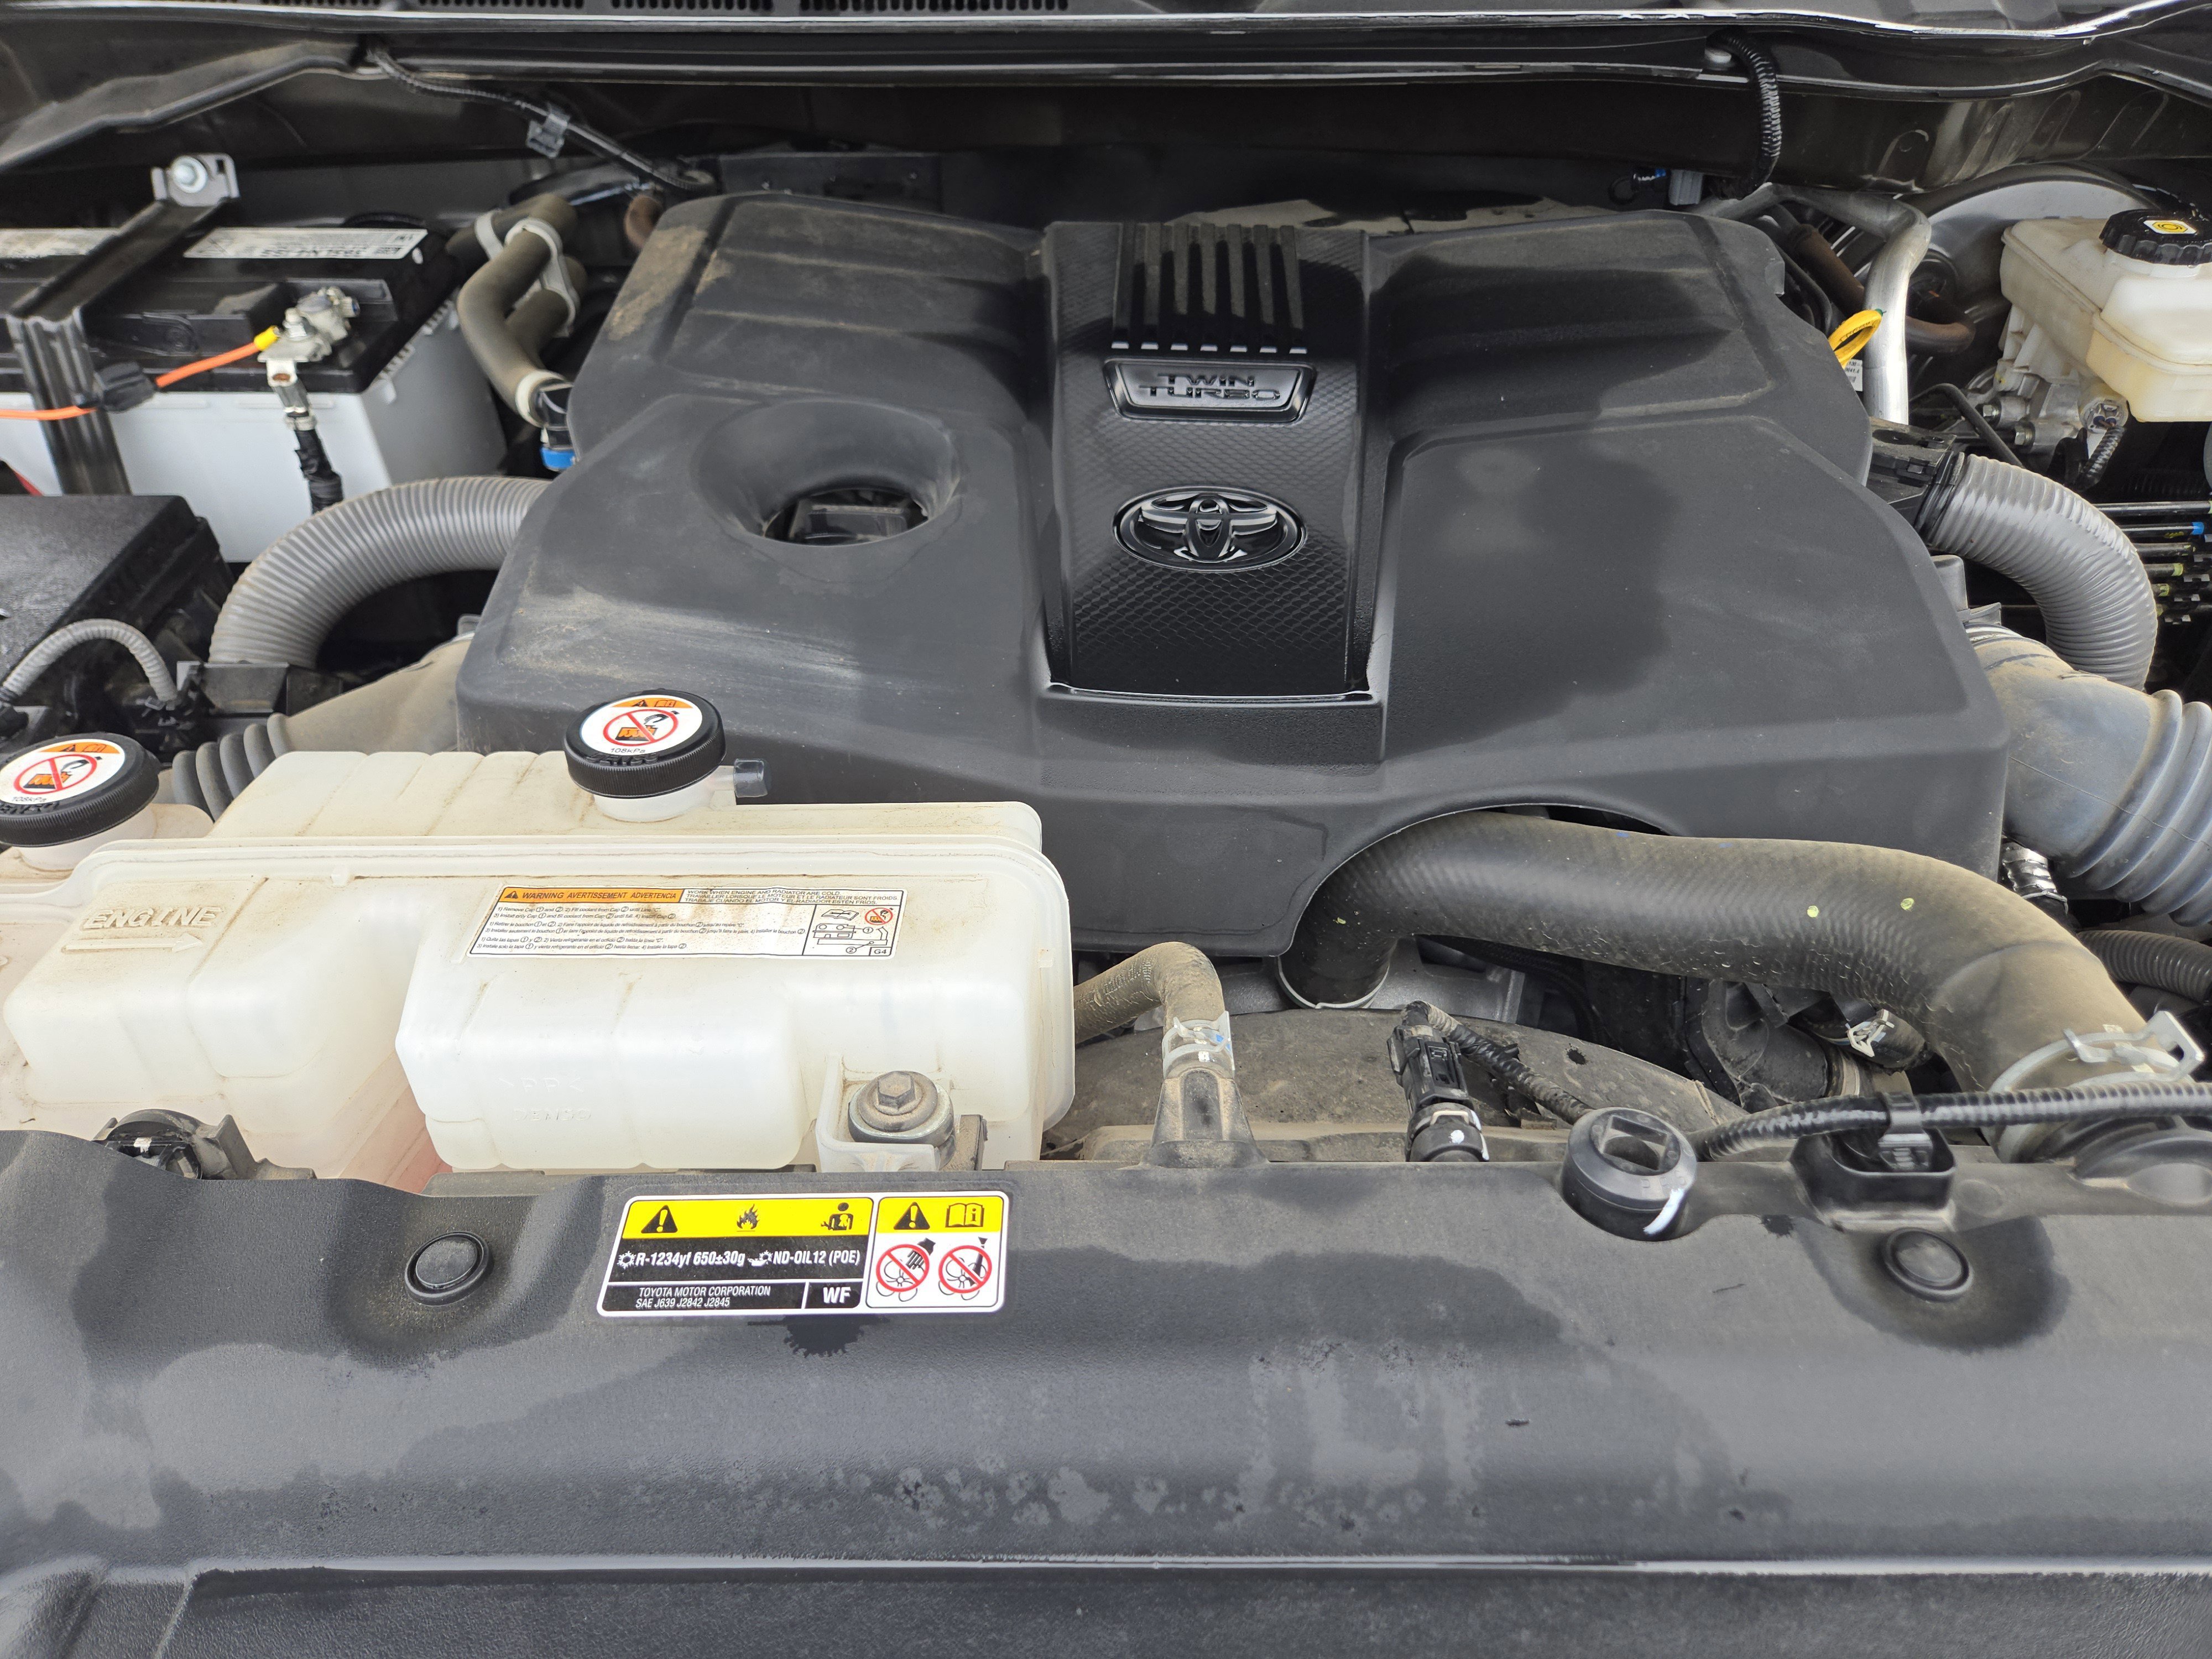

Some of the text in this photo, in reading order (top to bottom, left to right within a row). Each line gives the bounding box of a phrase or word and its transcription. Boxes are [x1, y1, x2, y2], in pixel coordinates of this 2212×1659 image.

[1157, 374, 1255, 387] TWIN
[1139, 385, 1281, 400] TURBO
[82, 906, 223, 930] ENGINE
[635, 1249, 860, 1268] R-1234yf 650±30g ND-OIL12 (POE)
[639, 1285, 771, 1297] TOYOTA MOTOR CORPORATION
[823, 1286, 851, 1303] WF
[636, 1297, 730, 1308] SAE J639 J2842 J2845
